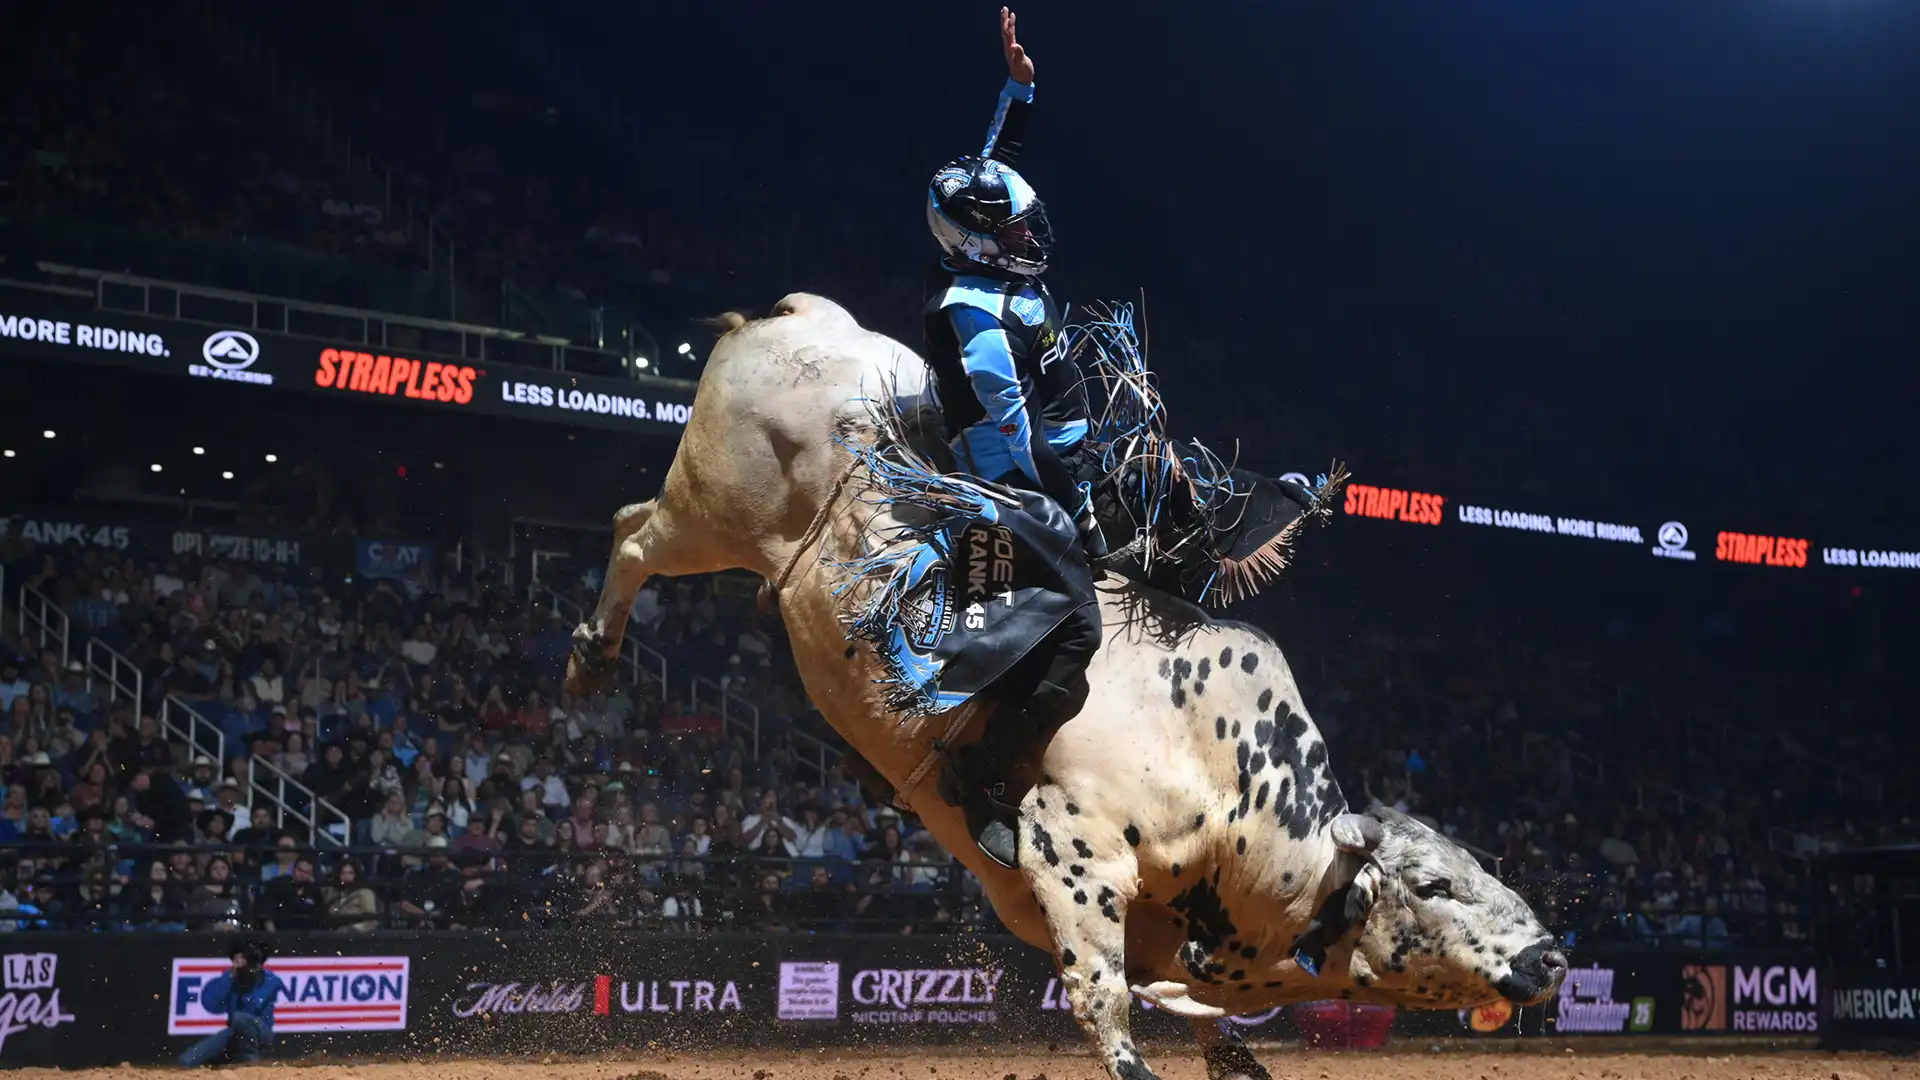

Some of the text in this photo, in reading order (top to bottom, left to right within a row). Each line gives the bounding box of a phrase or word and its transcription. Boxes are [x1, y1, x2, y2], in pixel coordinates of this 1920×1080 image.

[0, 314, 170, 357] MORE RIDING.
[316, 348, 476, 404] STRAPLESS
[503, 380, 553, 406] LESS
[558, 388, 651, 419] LOADING.
[1344, 484, 1443, 525] STRAPLESS
[1459, 505, 1644, 544] LESS LOADING. MORE RIDING.
[990, 525, 1014, 607] POET
[1716, 531, 1808, 568] STRAPLESS
[1823, 548, 1858, 566] LESS
[940, 588, 954, 629] CAROLINA
[9, 957, 51, 984] LAS
[275, 973, 403, 1002] NATION
[851, 968, 1004, 1009] GRIZZLY
[1734, 966, 1817, 1005] MGM
[452, 980, 742, 1018] Michelob ULTRA
[1833, 988, 1920, 1019] AMERICA'
[1733, 1010, 1818, 1031] REWARDS
